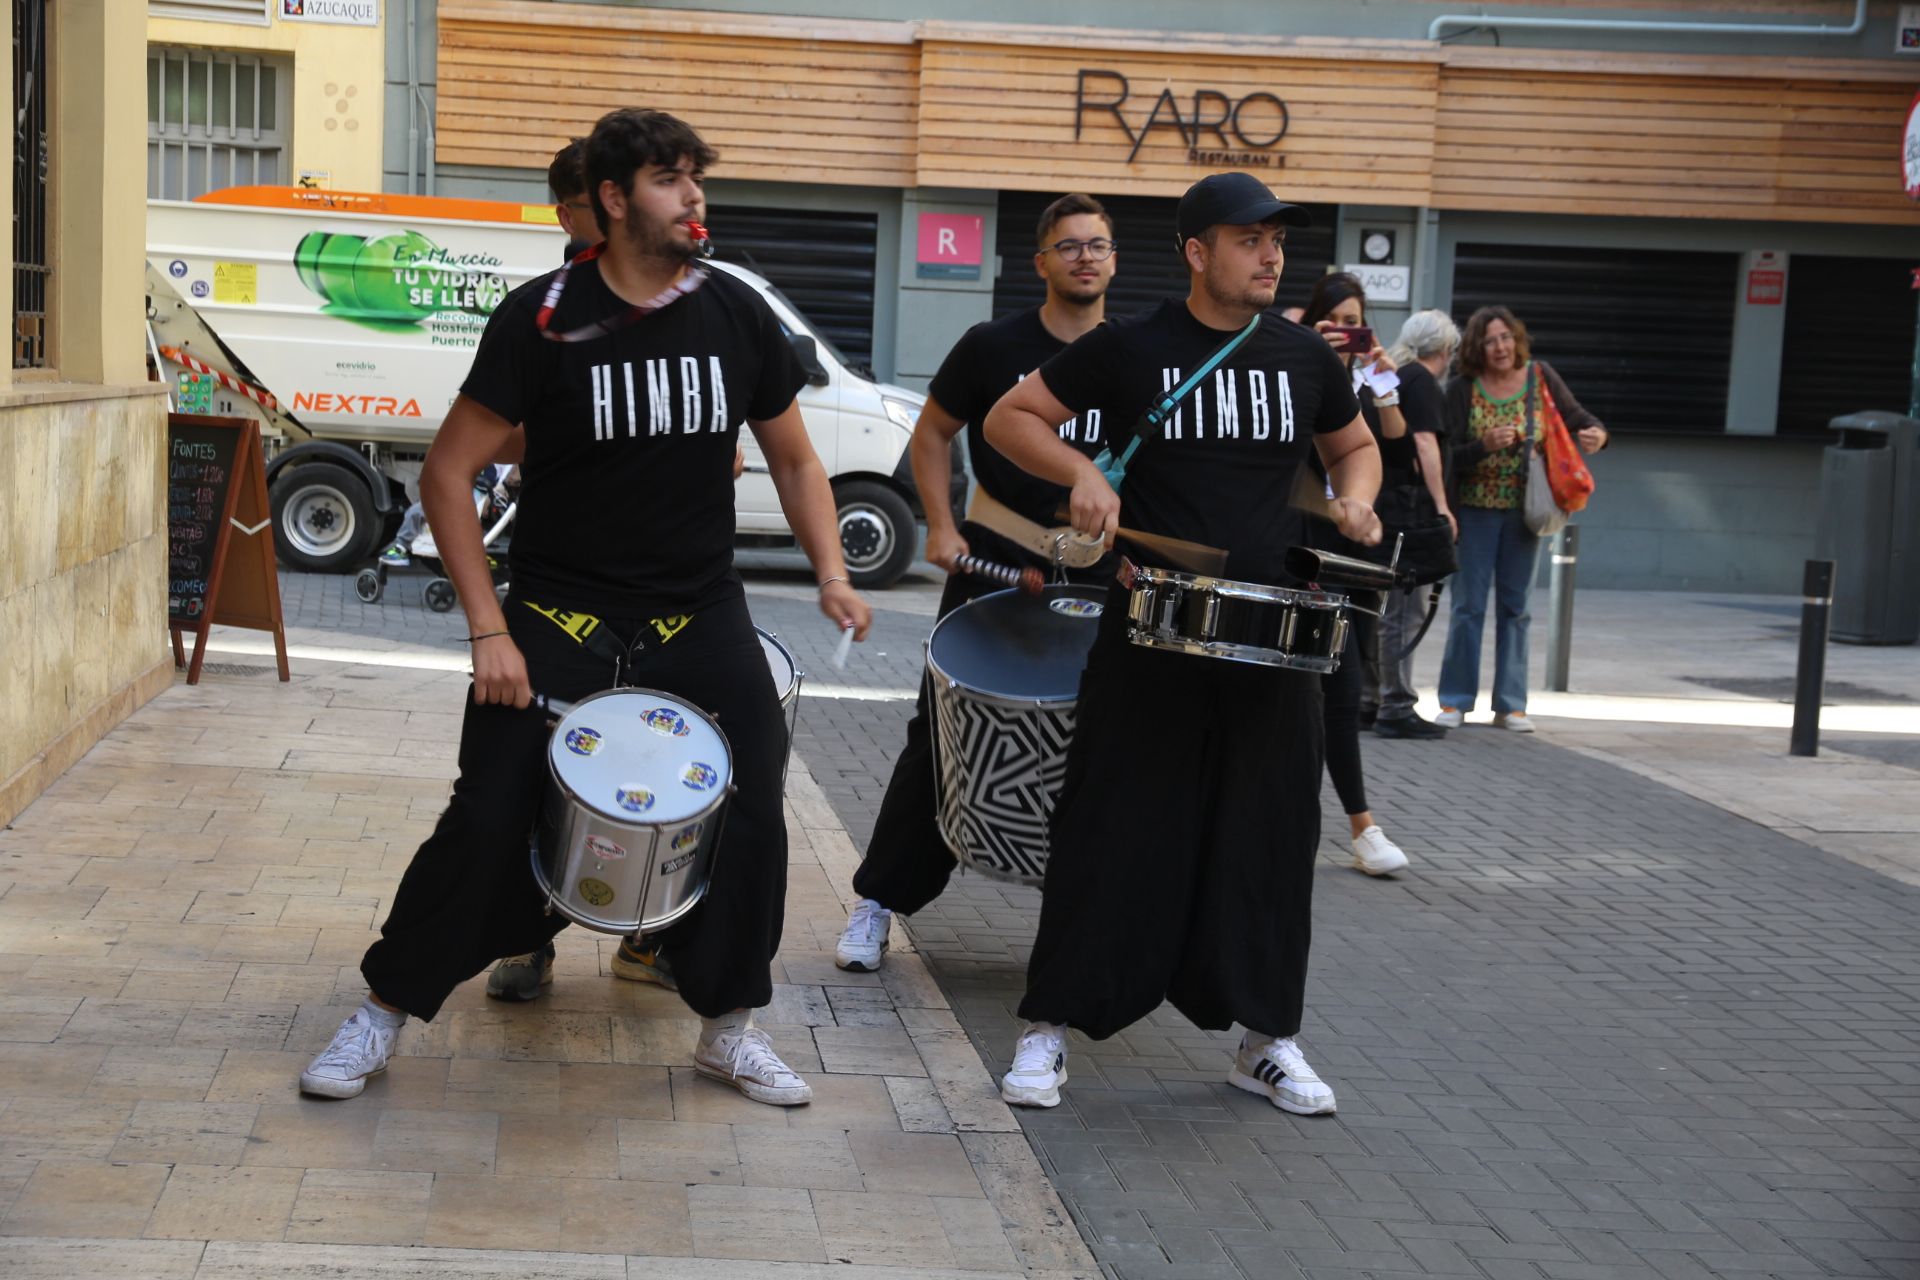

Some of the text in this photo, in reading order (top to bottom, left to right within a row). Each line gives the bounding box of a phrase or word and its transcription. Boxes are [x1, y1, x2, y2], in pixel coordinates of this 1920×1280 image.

[306, 1, 374, 21] AZUCAQUE
[1075, 69, 1289, 164] RARO
[1189, 149, 1287, 169] RESTAURANE
[938, 227, 958, 255] R
[393, 244, 503, 267] En Murcia
[392, 268, 505, 290] TU VIDRIO
[409, 288, 502, 308] SE LLEVA
[432, 336, 475, 348] Puerta
[336, 360, 377, 371] ecovidrio
[292, 391, 422, 418] NEXTRA
[590, 356, 728, 441] HIMBA
[1162, 367, 1295, 442] HIMBA
[173, 438, 217, 461] FONTES
